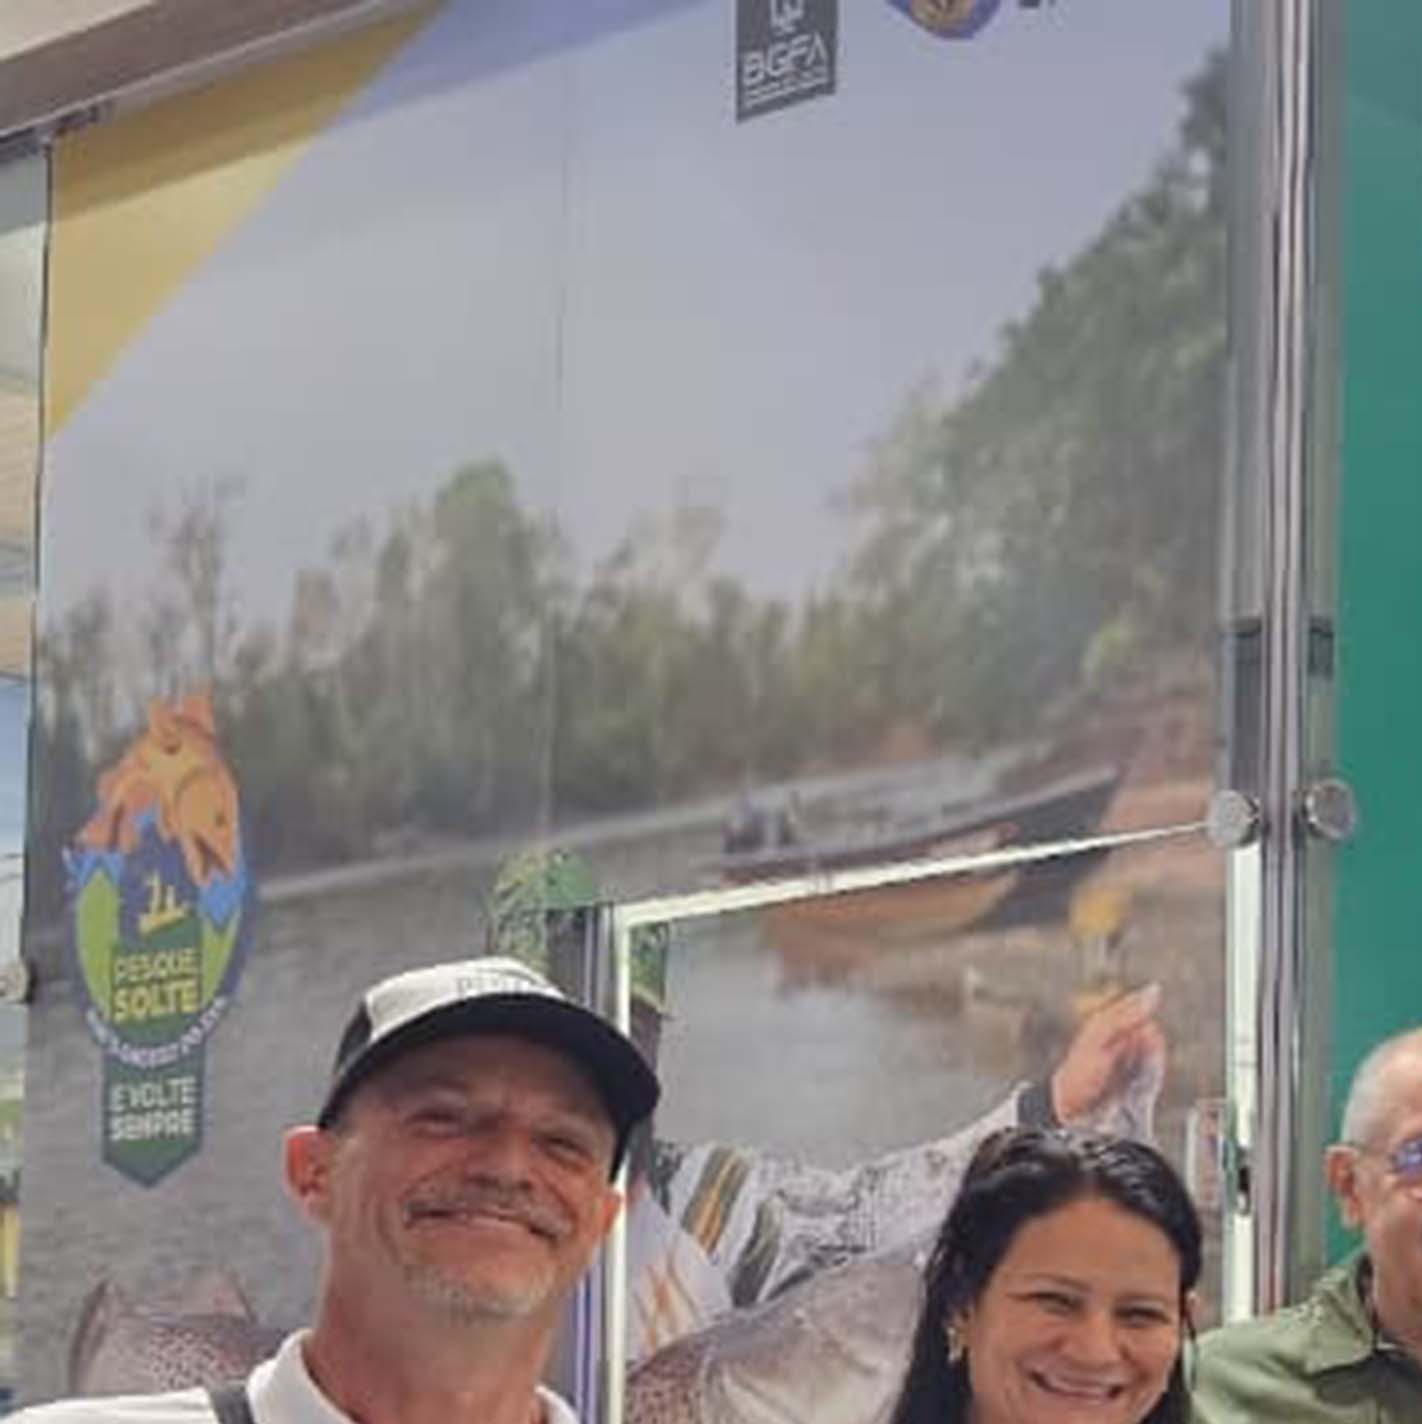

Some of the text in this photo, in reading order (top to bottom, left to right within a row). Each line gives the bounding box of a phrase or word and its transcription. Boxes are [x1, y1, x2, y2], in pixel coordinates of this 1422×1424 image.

[114, 947, 200, 985] PESQUE
[113, 980, 201, 1024] SOLTE
[127, 1076, 196, 1109] VOLTE
